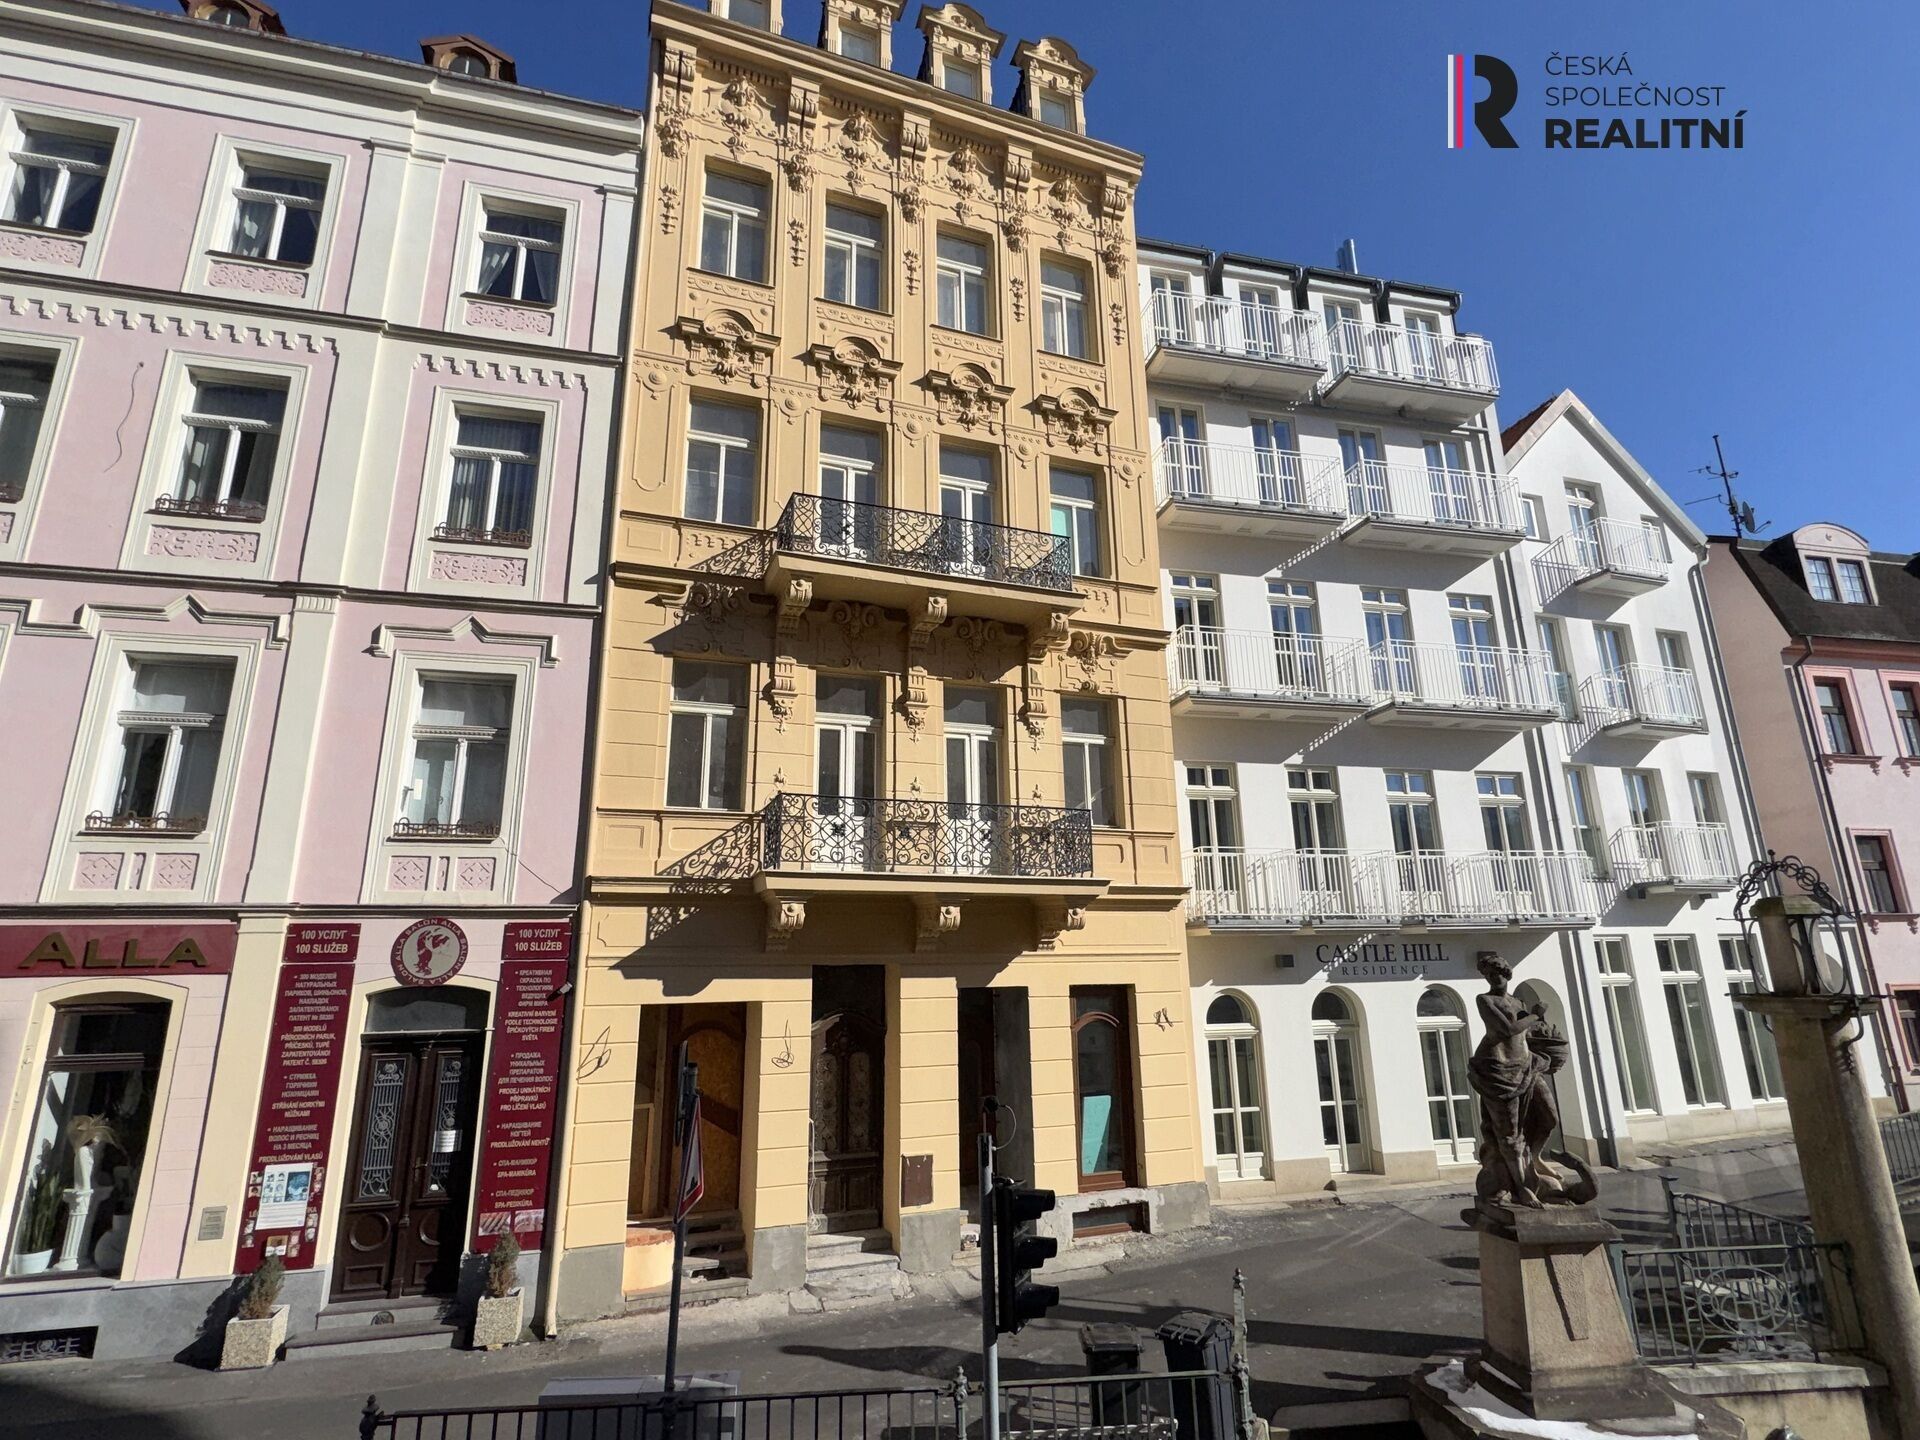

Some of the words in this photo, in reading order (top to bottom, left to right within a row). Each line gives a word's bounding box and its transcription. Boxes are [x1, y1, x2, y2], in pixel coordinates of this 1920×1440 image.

[301, 929, 316, 940] 100
[317, 929, 347, 939] УСЛУГ
[519, 928, 533, 939] 100
[534, 928, 561, 938] УСЛУГ
[17, 931, 209, 969] ALLA
[296, 944, 311, 954] 100
[312, 942, 349, 954] SLUŽEB
[515, 942, 529, 952] 100
[530, 940, 563, 951] SLUŽEB
[1316, 943, 1397, 963] CASTLE
[1402, 943, 1449, 962] HILL
[1342, 965, 1428, 976] RESIDENCE
